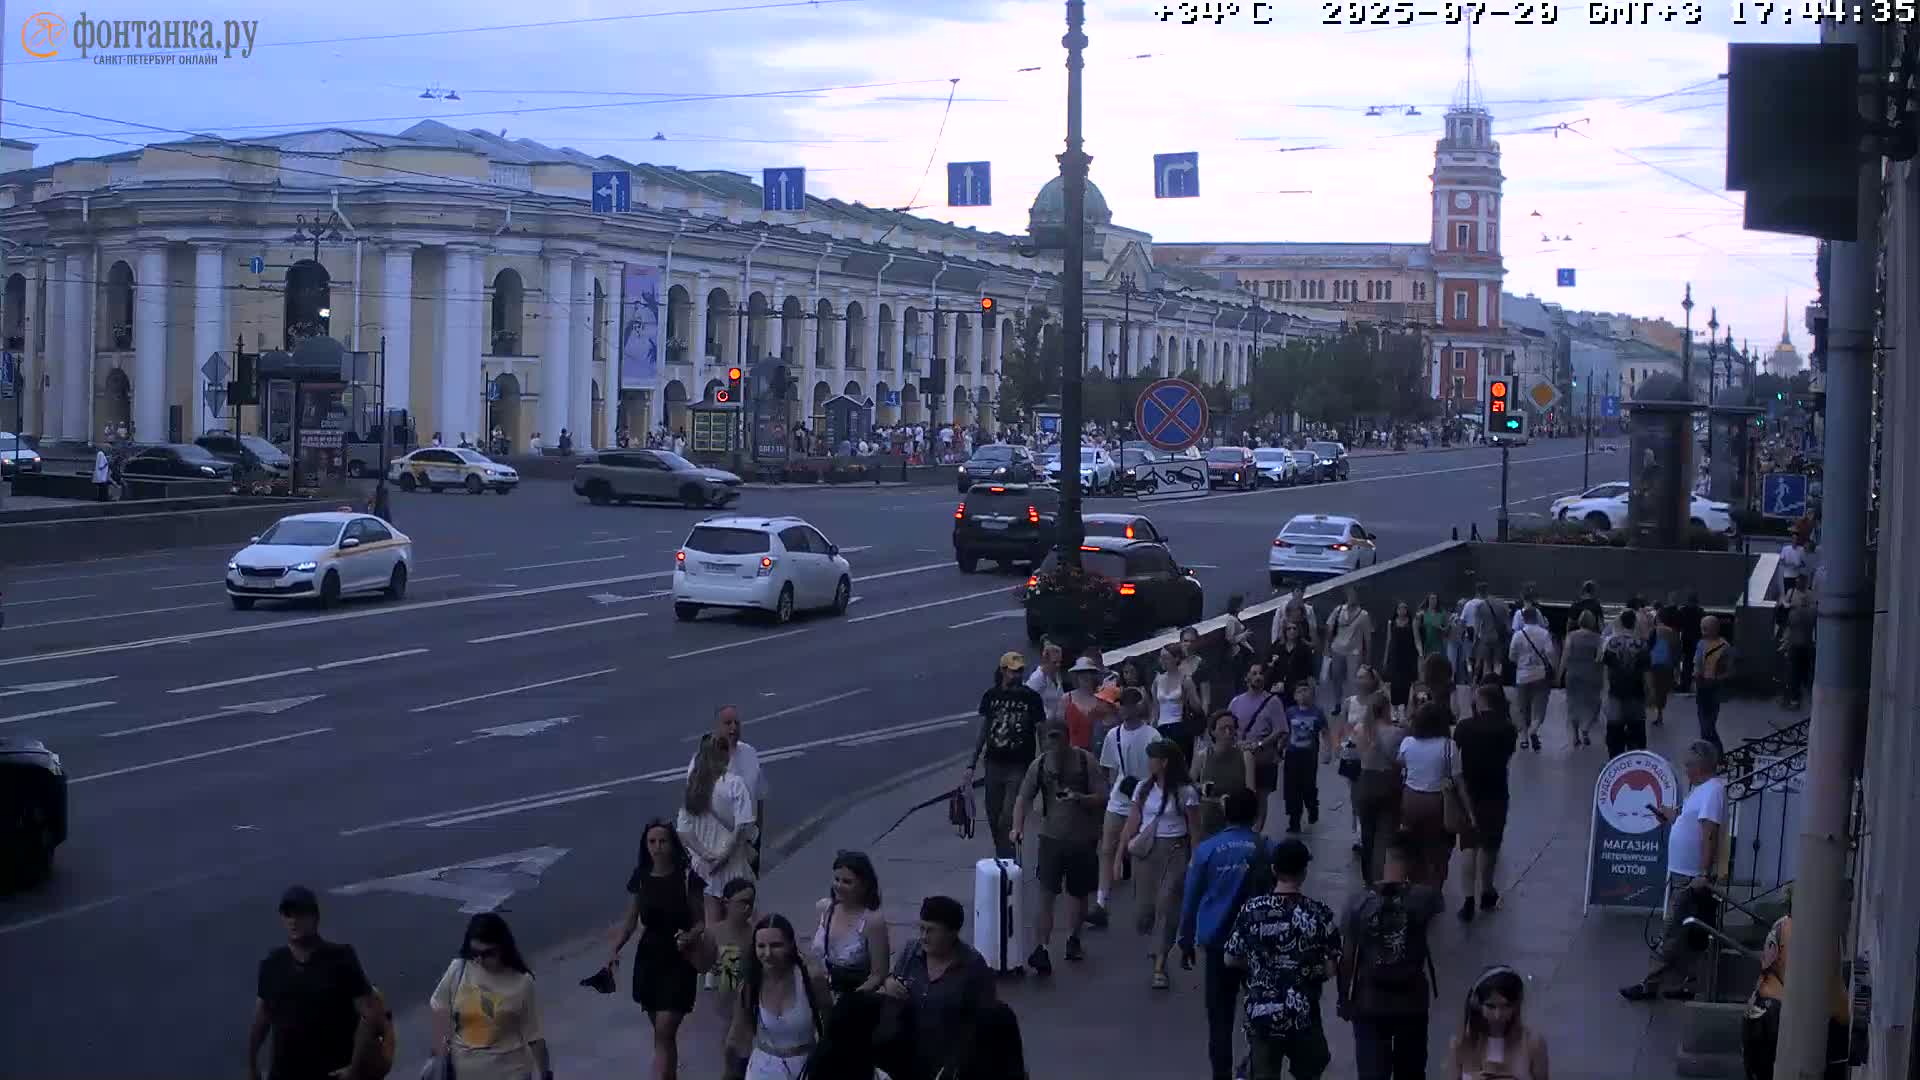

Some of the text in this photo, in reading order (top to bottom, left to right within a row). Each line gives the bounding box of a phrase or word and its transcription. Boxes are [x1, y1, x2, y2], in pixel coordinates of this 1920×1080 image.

[1599, 759, 1633, 805] ЧУДЕСНОЕ
[1603, 839, 1659, 852] МАГАЗИН
[1611, 863, 1647, 875] КОТОВ
